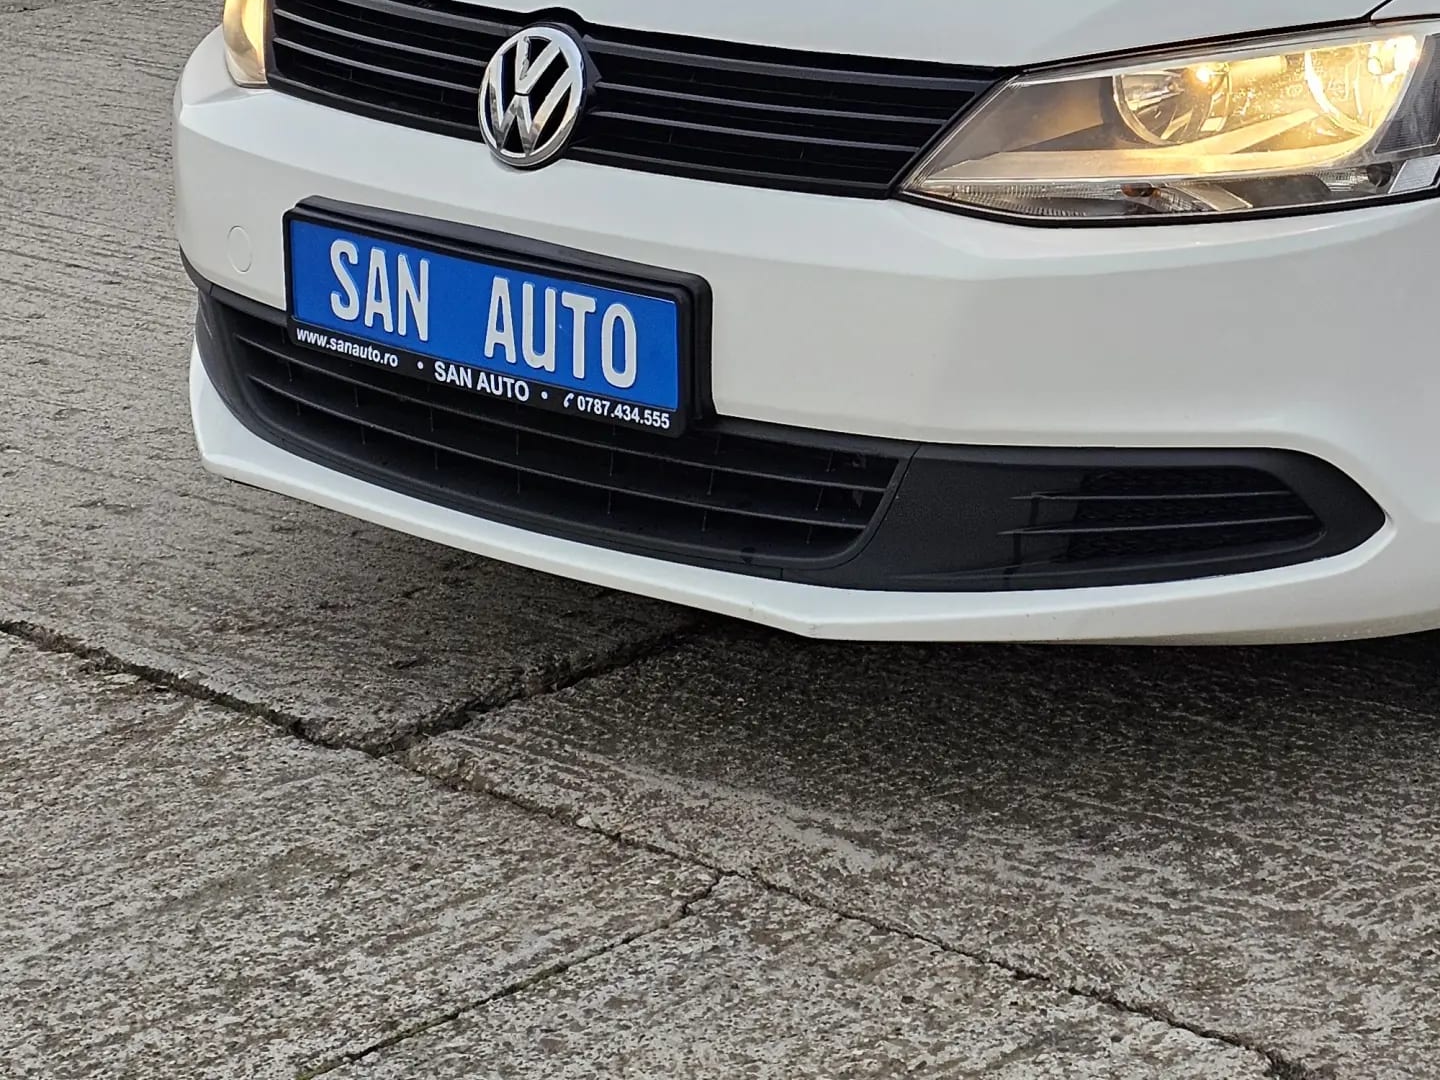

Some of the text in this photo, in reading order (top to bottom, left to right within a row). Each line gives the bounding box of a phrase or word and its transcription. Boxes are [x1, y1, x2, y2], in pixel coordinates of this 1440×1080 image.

[329, 238, 638, 389] SAN AUTO
[296, 326, 671, 430] www.sanauto.ro SAN AUTO 0787.434.555
